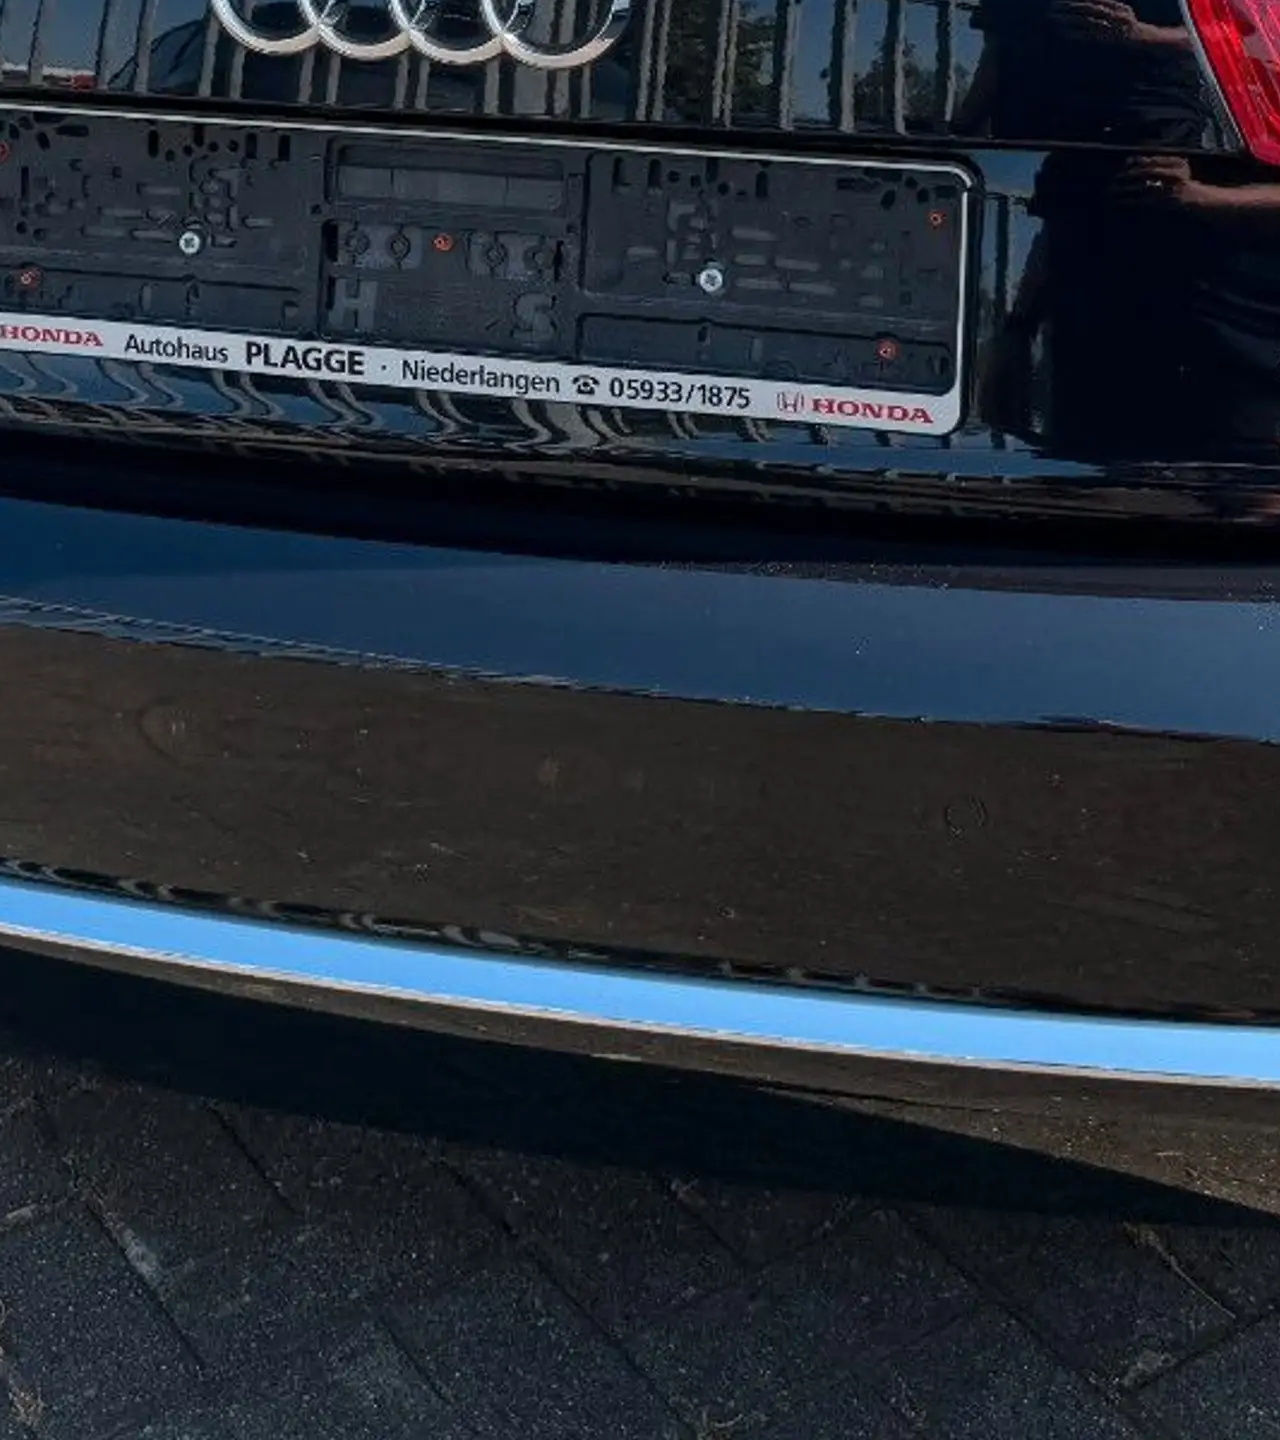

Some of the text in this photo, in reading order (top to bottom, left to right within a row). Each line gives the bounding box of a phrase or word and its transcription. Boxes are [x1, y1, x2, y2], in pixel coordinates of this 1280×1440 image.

[0, 324, 934, 424] HONDA Autohaus PLAGGE Niederlangen 05933/1875 HONDA
